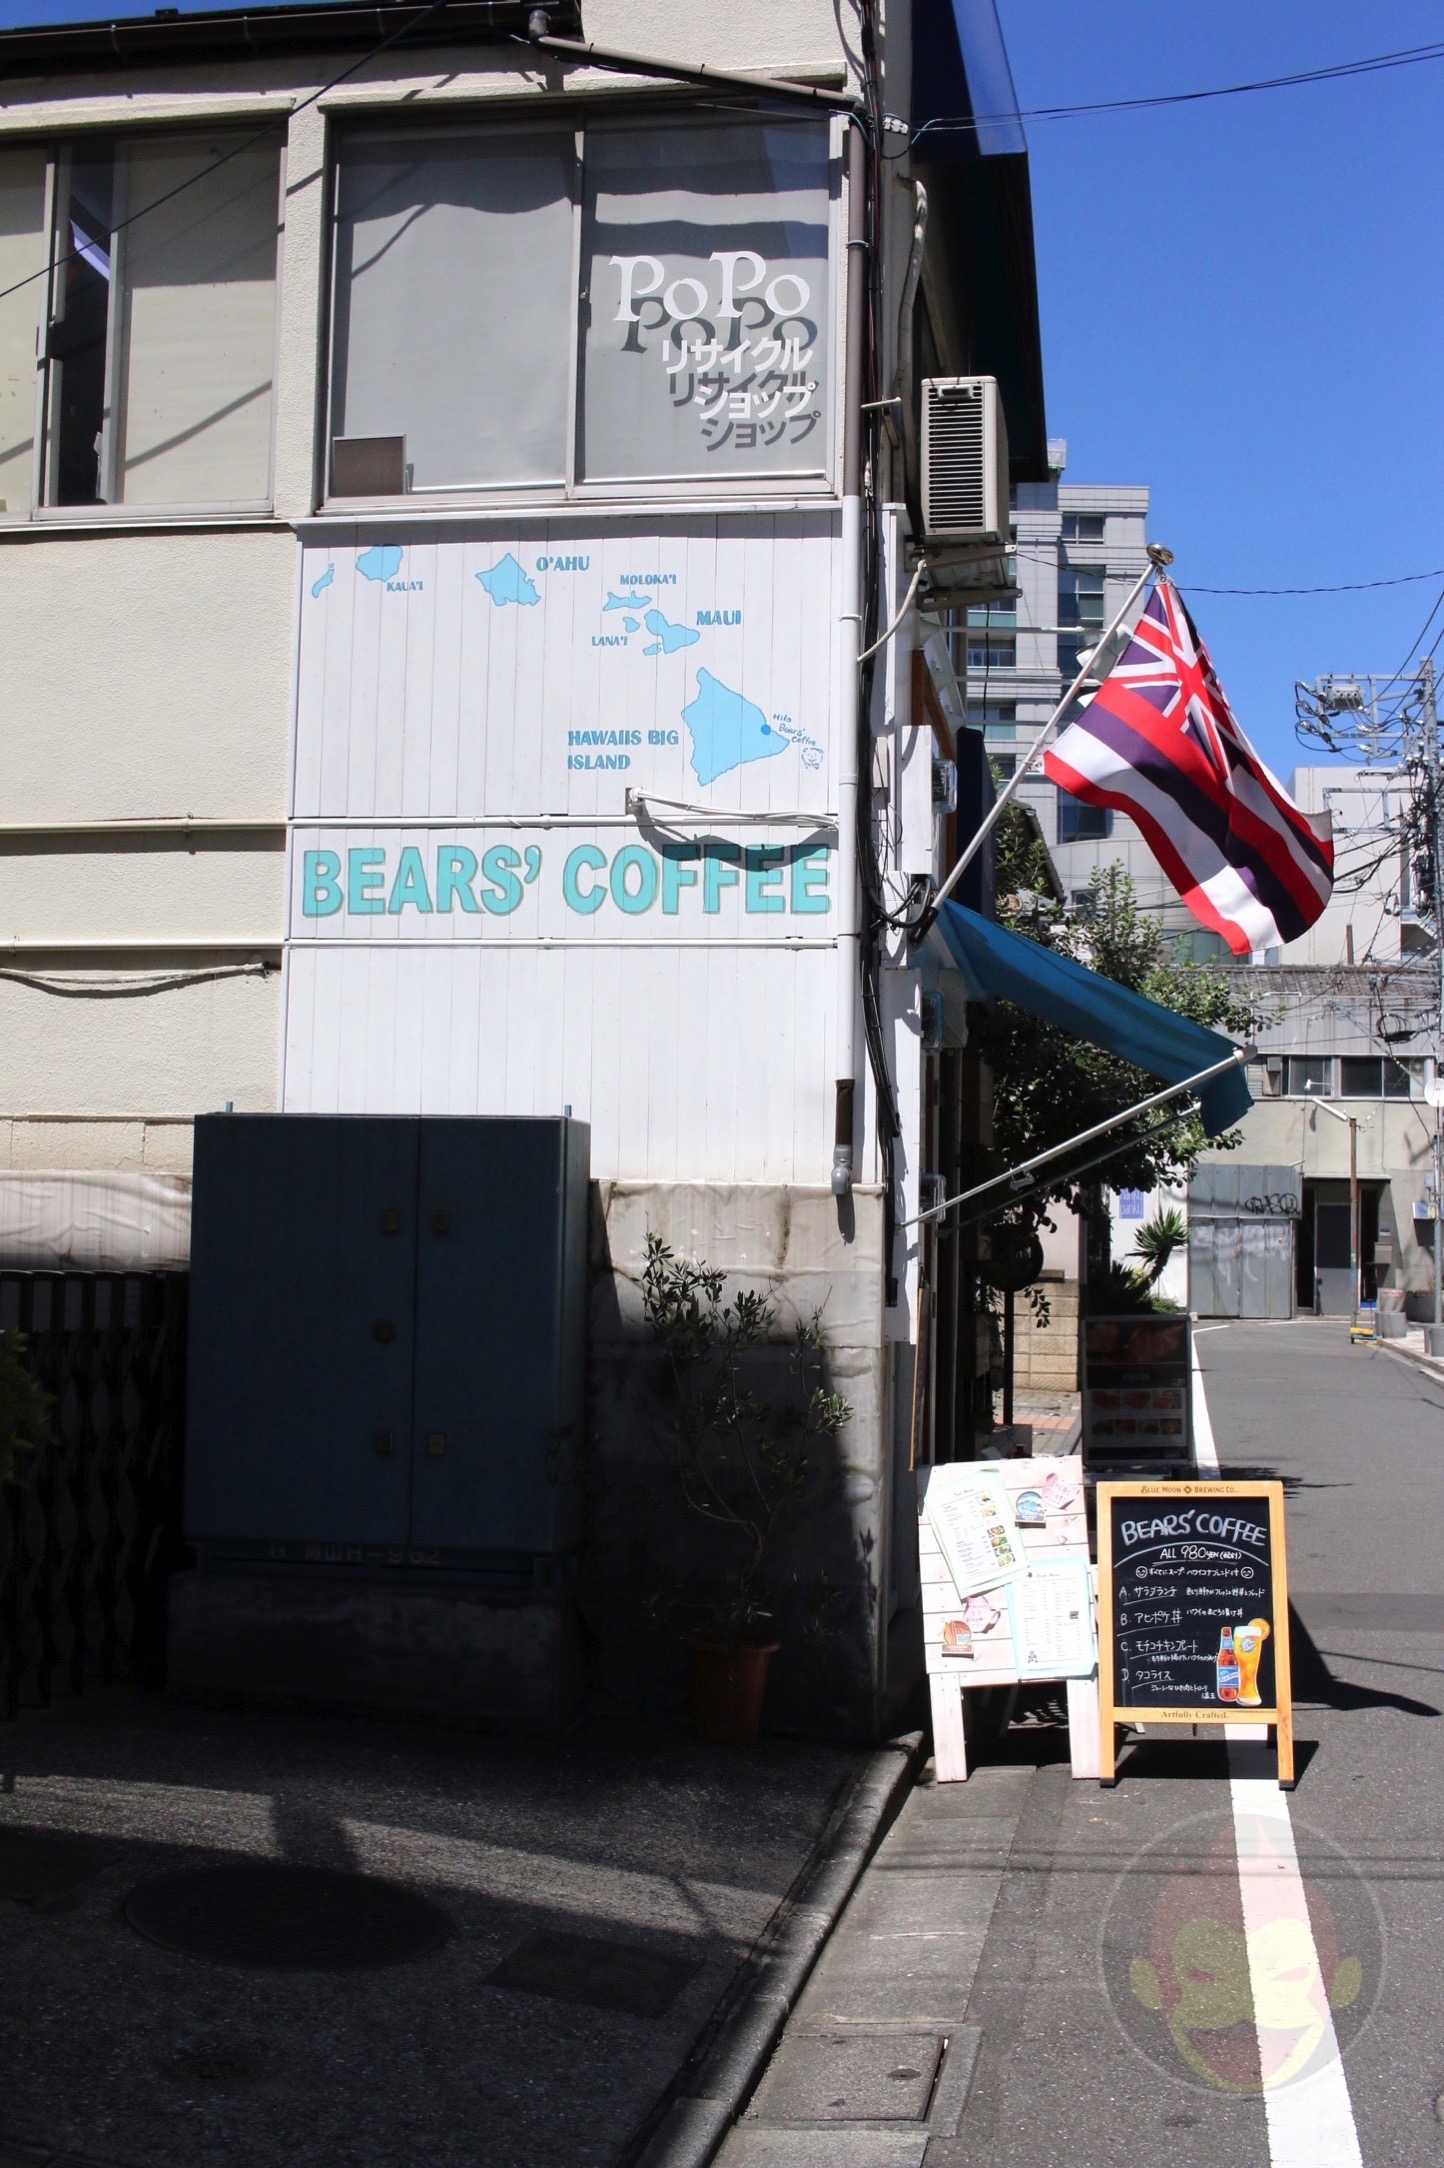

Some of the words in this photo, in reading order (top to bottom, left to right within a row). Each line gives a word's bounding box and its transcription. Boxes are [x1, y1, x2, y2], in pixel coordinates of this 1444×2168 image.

[609, 250, 811, 322] PoPo
[662, 337, 814, 375] リサイクル
[693, 381, 818, 421] ショップ
[536, 556, 590, 571] O'AHU
[386, 581, 424, 592] KAUA'I
[619, 574, 677, 585] MOLOKA'I
[696, 610, 742, 626] MAUI
[591, 636, 628, 646] LANA'I
[567, 730, 642, 746] HAWAIIS
[647, 730, 679, 746] BIG
[567, 754, 631, 770] ISLAND
[302, 843, 543, 917] BEARS'
[562, 842, 832, 916] COFFEE
[1195, 1513, 1268, 1546] COFFEE
[1160, 1548, 1177, 1559] ALL
[1134, 1586, 1178, 1597] サラダランチ
[1136, 1670, 1171, 1680] タコライス
